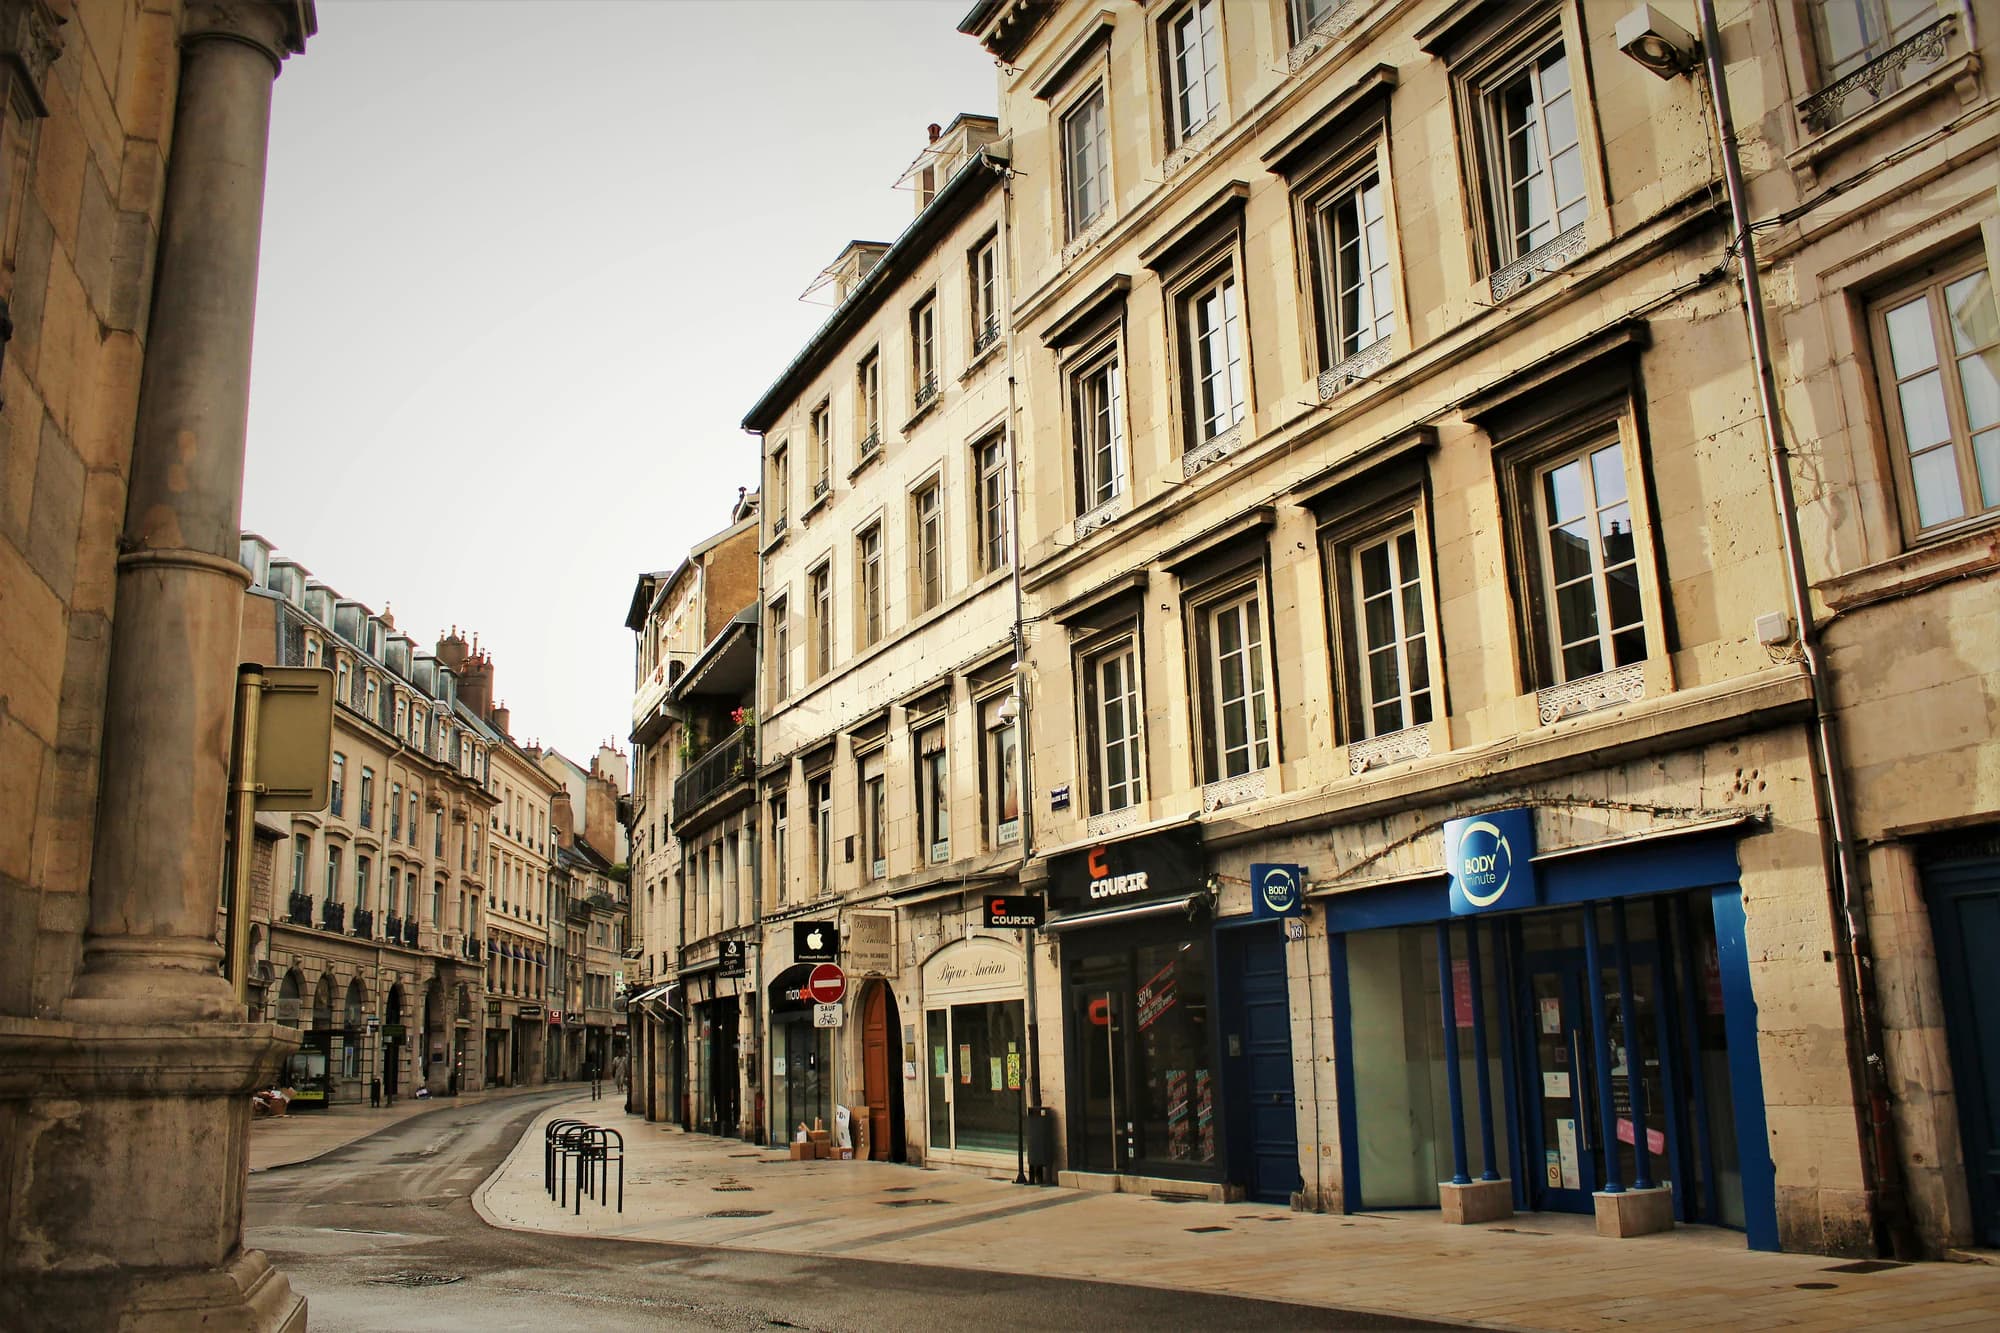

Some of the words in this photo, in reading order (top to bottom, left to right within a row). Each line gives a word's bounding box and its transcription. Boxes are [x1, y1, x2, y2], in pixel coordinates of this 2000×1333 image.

[1464, 853, 1497, 875] BODY
[1090, 871, 1149, 899] COURIR
[1268, 886, 1288, 895] BODY
[991, 916, 1035, 925] COURIR
[1291, 926, 1303, 939] 109
[937, 962, 967, 985] Bijoux
[969, 957, 1006, 977] Anciens
